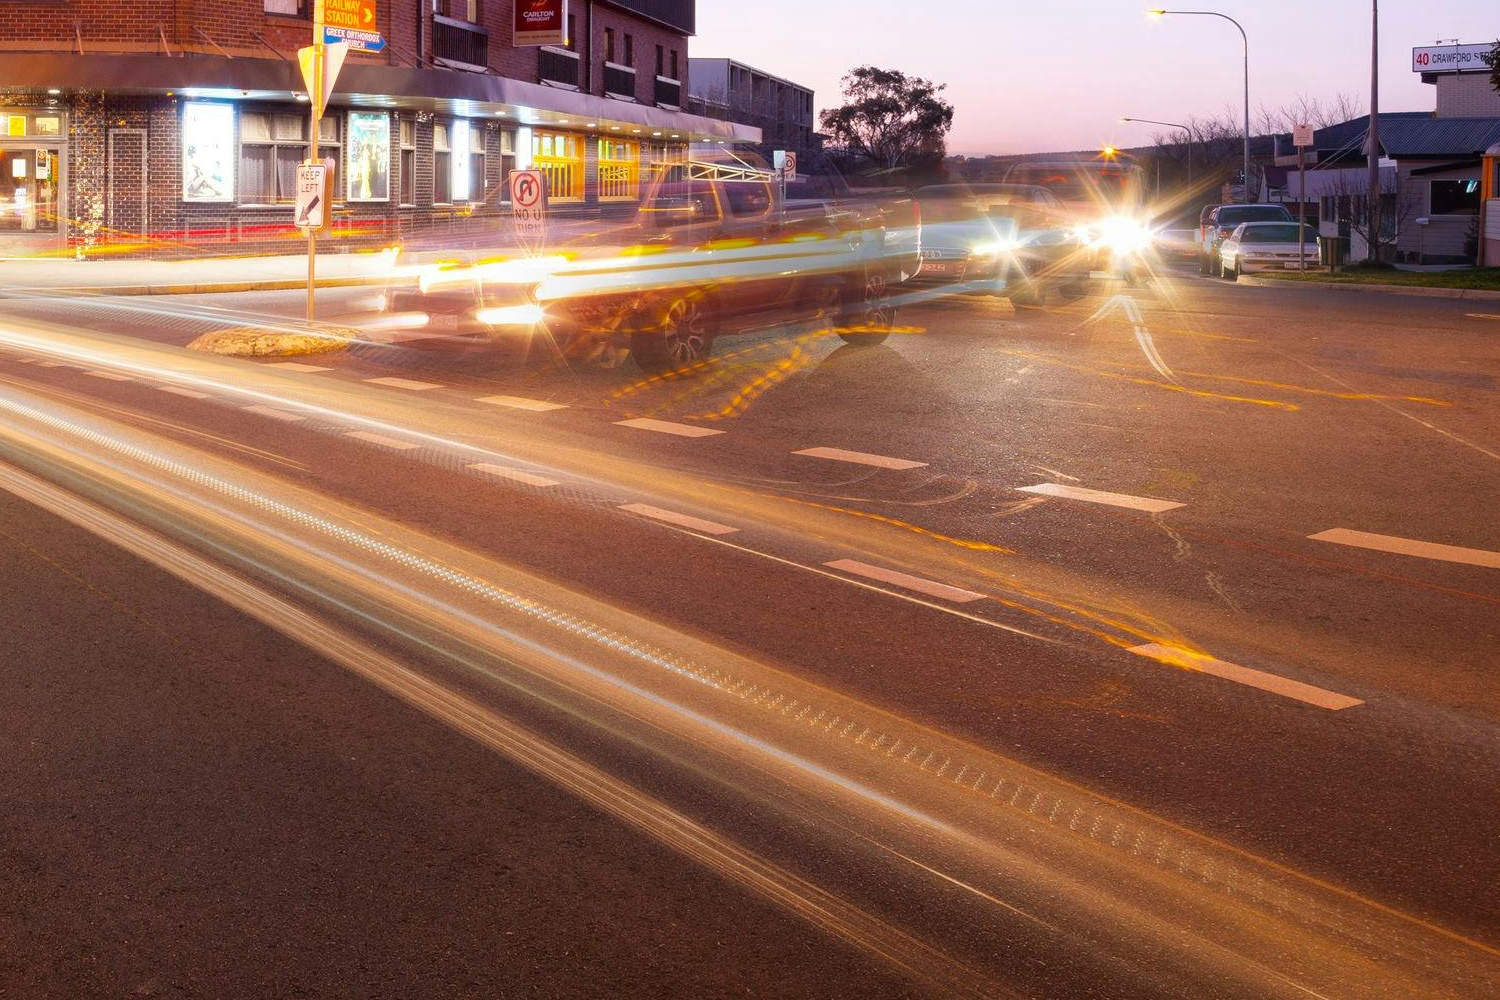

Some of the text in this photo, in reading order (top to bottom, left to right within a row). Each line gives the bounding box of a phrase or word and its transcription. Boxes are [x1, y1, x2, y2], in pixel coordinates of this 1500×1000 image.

[325, 10, 360, 25] STATION
[522, 10, 554, 18] CARLTON
[326, 27, 380, 43] GREEK ORTHODOX
[1416, 52, 1429, 66] 40
[1431, 52, 1472, 64] CRAWFORD
[301, 170, 320, 180] KEEP
[301, 183, 319, 193] LEFT
[515, 208, 541, 221] NO U
[516, 223, 542, 234] TURN
